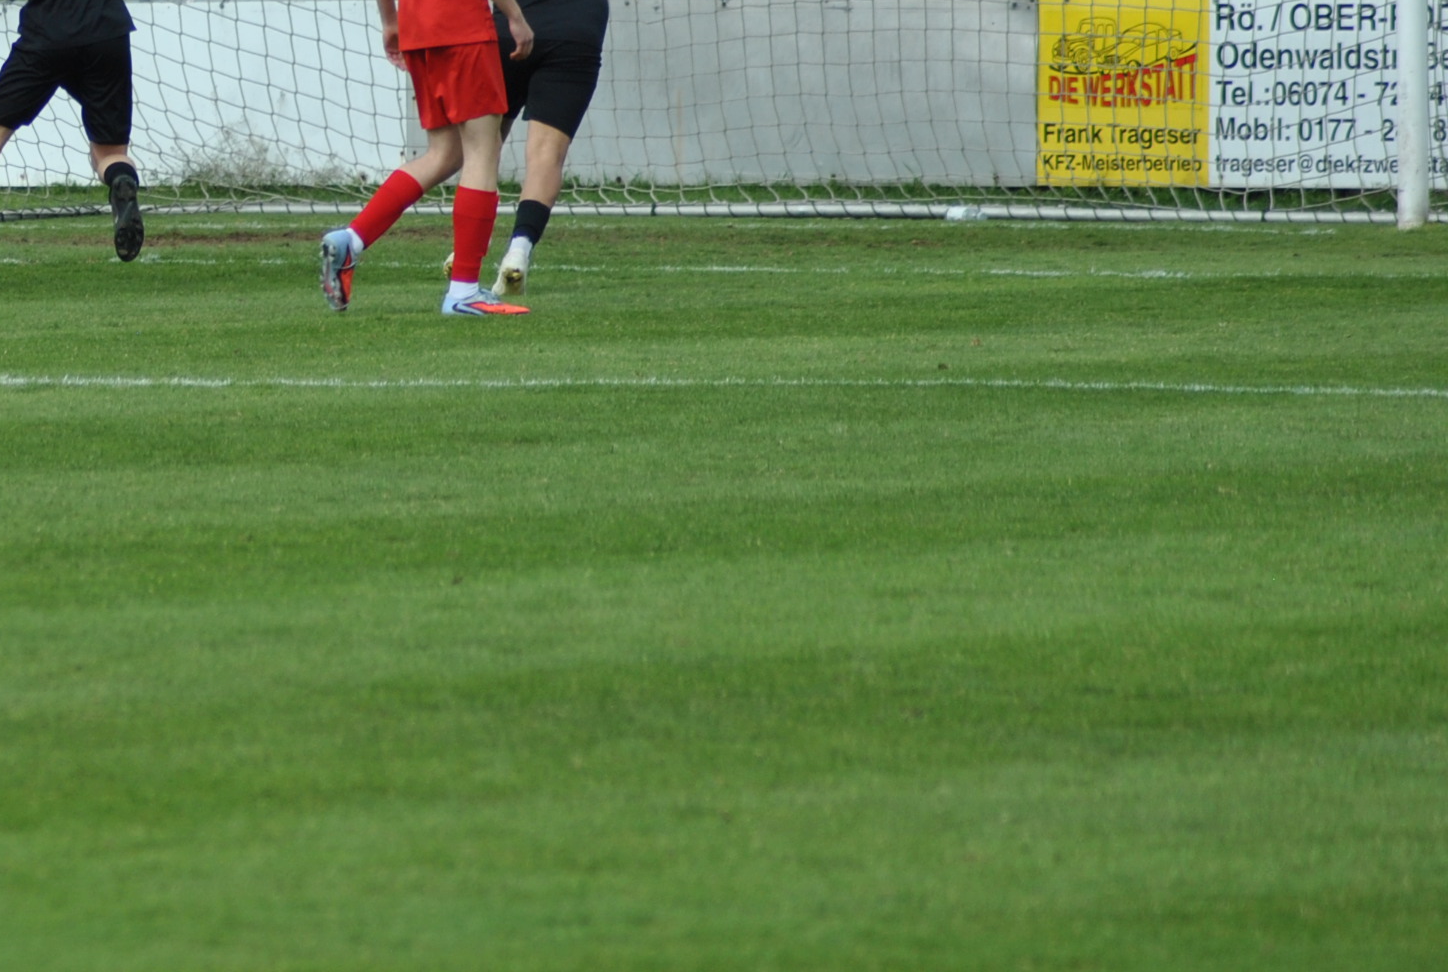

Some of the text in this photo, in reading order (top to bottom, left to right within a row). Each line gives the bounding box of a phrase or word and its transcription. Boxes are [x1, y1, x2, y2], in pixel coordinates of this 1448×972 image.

[1048, 53, 1197, 108] DIE WERKSTATT
[1043, 123, 1201, 149] Frank Trageser
[1215, 117, 1290, 141] Mobil:
[1299, 118, 1356, 141] 0177
[1043, 154, 1202, 173] KFZ-Meisterbetrieb
